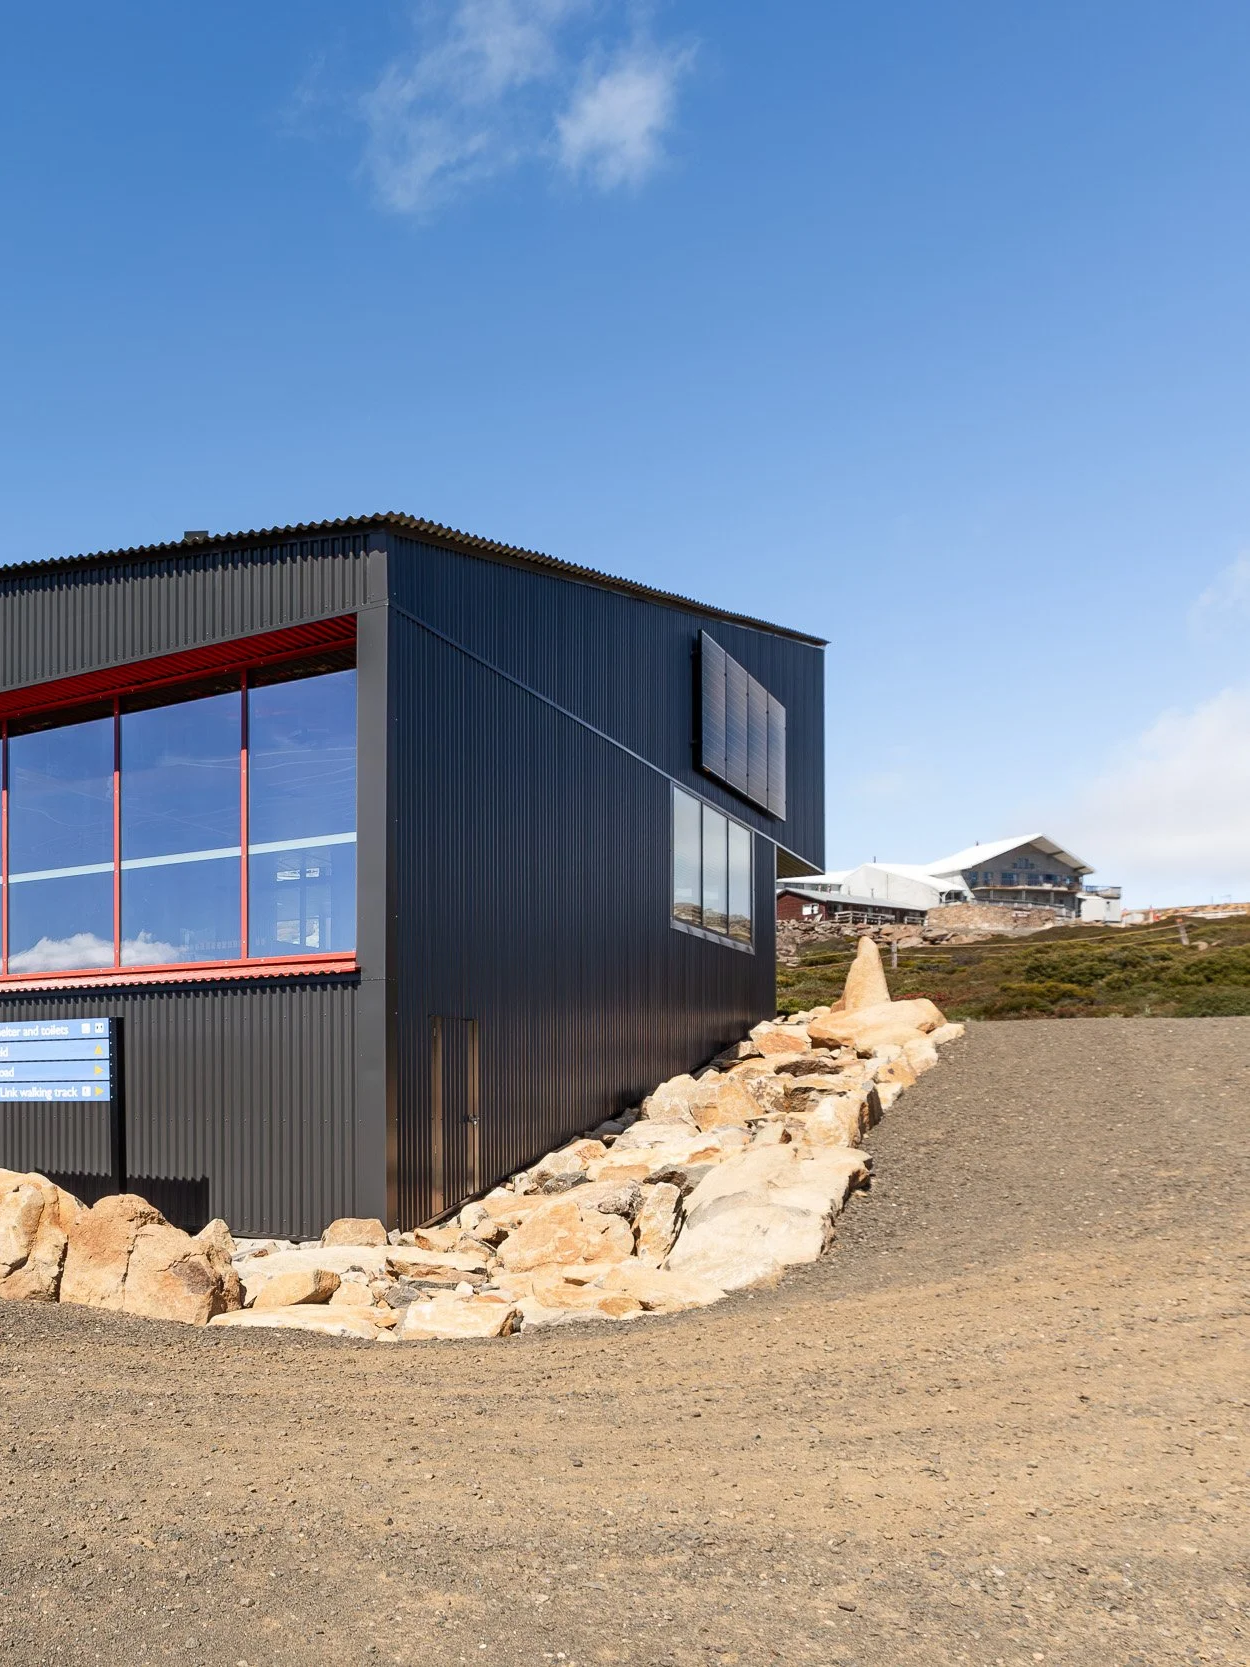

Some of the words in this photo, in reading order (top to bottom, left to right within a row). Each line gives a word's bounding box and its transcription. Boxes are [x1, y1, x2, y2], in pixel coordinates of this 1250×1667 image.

[23, 1026, 39, 1036] and
[41, 1025, 69, 1035] toilets
[0, 1087, 18, 1097] Link
[19, 1087, 52, 1100] walking
[54, 1087, 78, 1097] track
